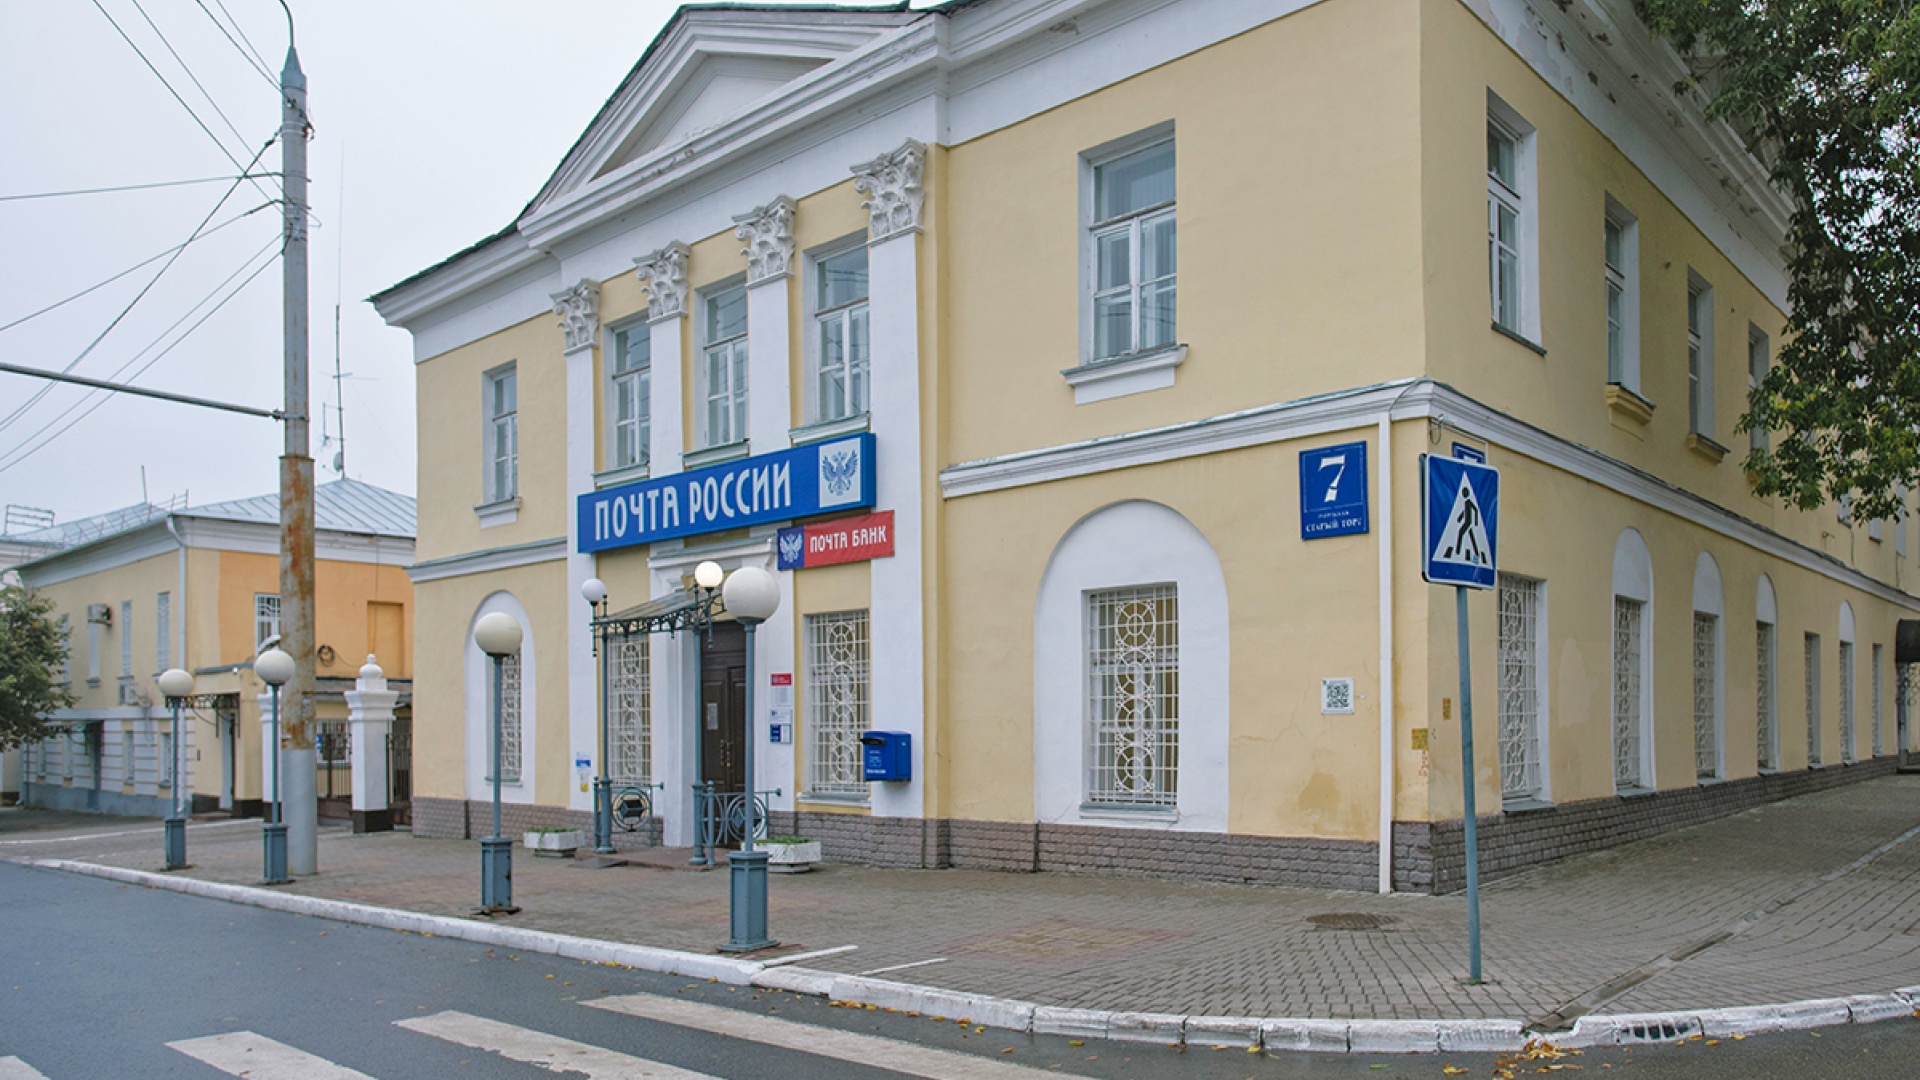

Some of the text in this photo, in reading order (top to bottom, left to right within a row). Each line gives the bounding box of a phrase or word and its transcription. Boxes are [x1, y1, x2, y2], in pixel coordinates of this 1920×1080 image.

[595, 460, 792, 541] ПОЧТА РОССИИ
[1319, 455, 1346, 502] 7
[810, 525, 887, 553] ПОЧТА БАНК
